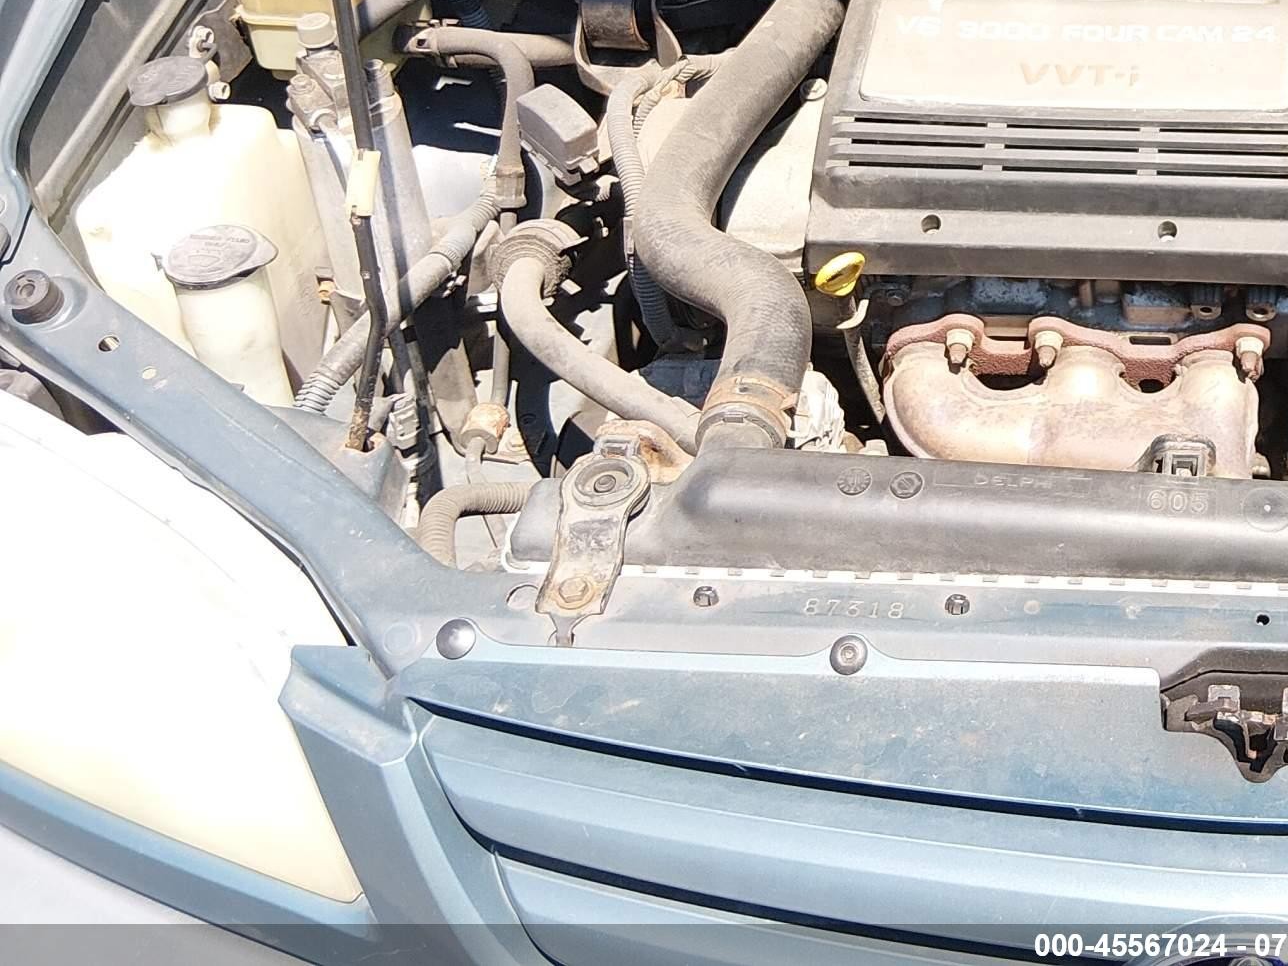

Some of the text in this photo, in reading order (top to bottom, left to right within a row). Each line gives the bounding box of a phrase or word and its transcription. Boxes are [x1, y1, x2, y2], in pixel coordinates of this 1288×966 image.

[896, 14, 1278, 43] V6 3000 FOUR CAM 24
[1018, 61, 1142, 88] VVT-i
[1146, 489, 1209, 514] 605
[803, 597, 905, 619] 87318
